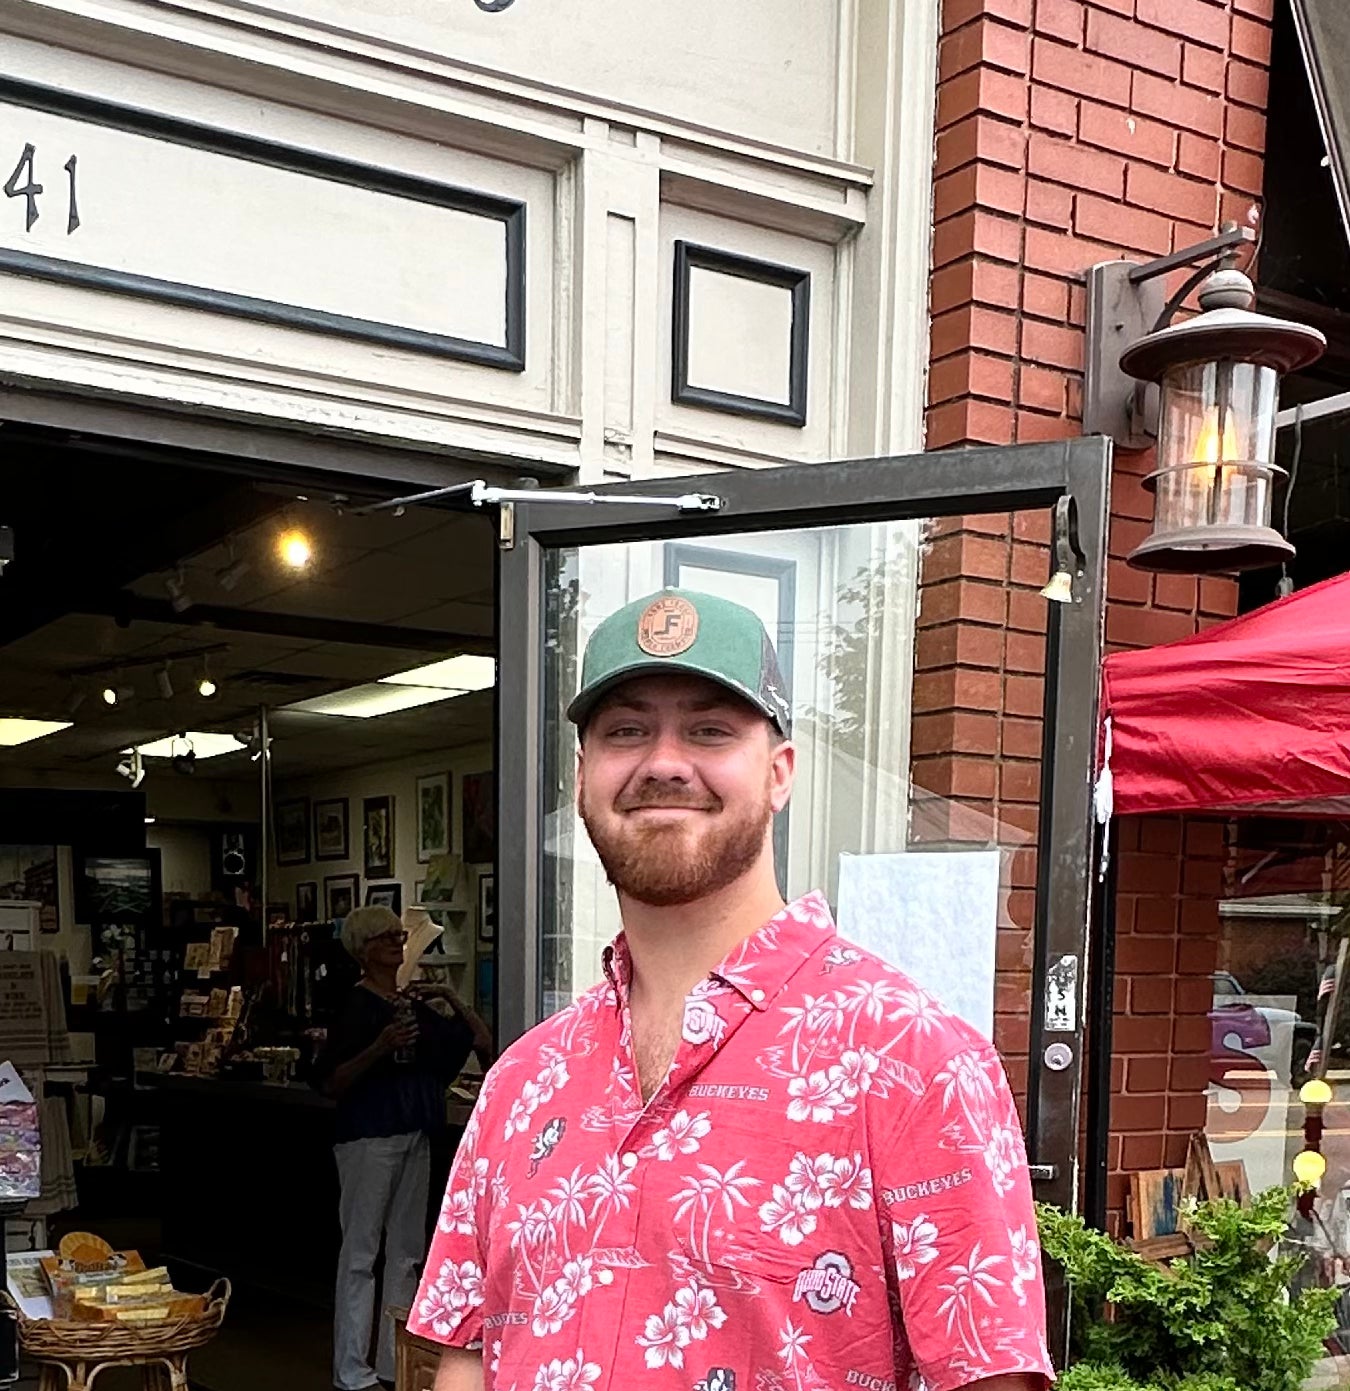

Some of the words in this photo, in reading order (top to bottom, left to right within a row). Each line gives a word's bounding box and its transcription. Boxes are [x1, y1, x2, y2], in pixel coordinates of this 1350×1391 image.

[3, 142, 80, 235] 41
[688, 1084, 770, 1102] BUCKEYES
[882, 1166, 973, 1207] BUCKEYES
